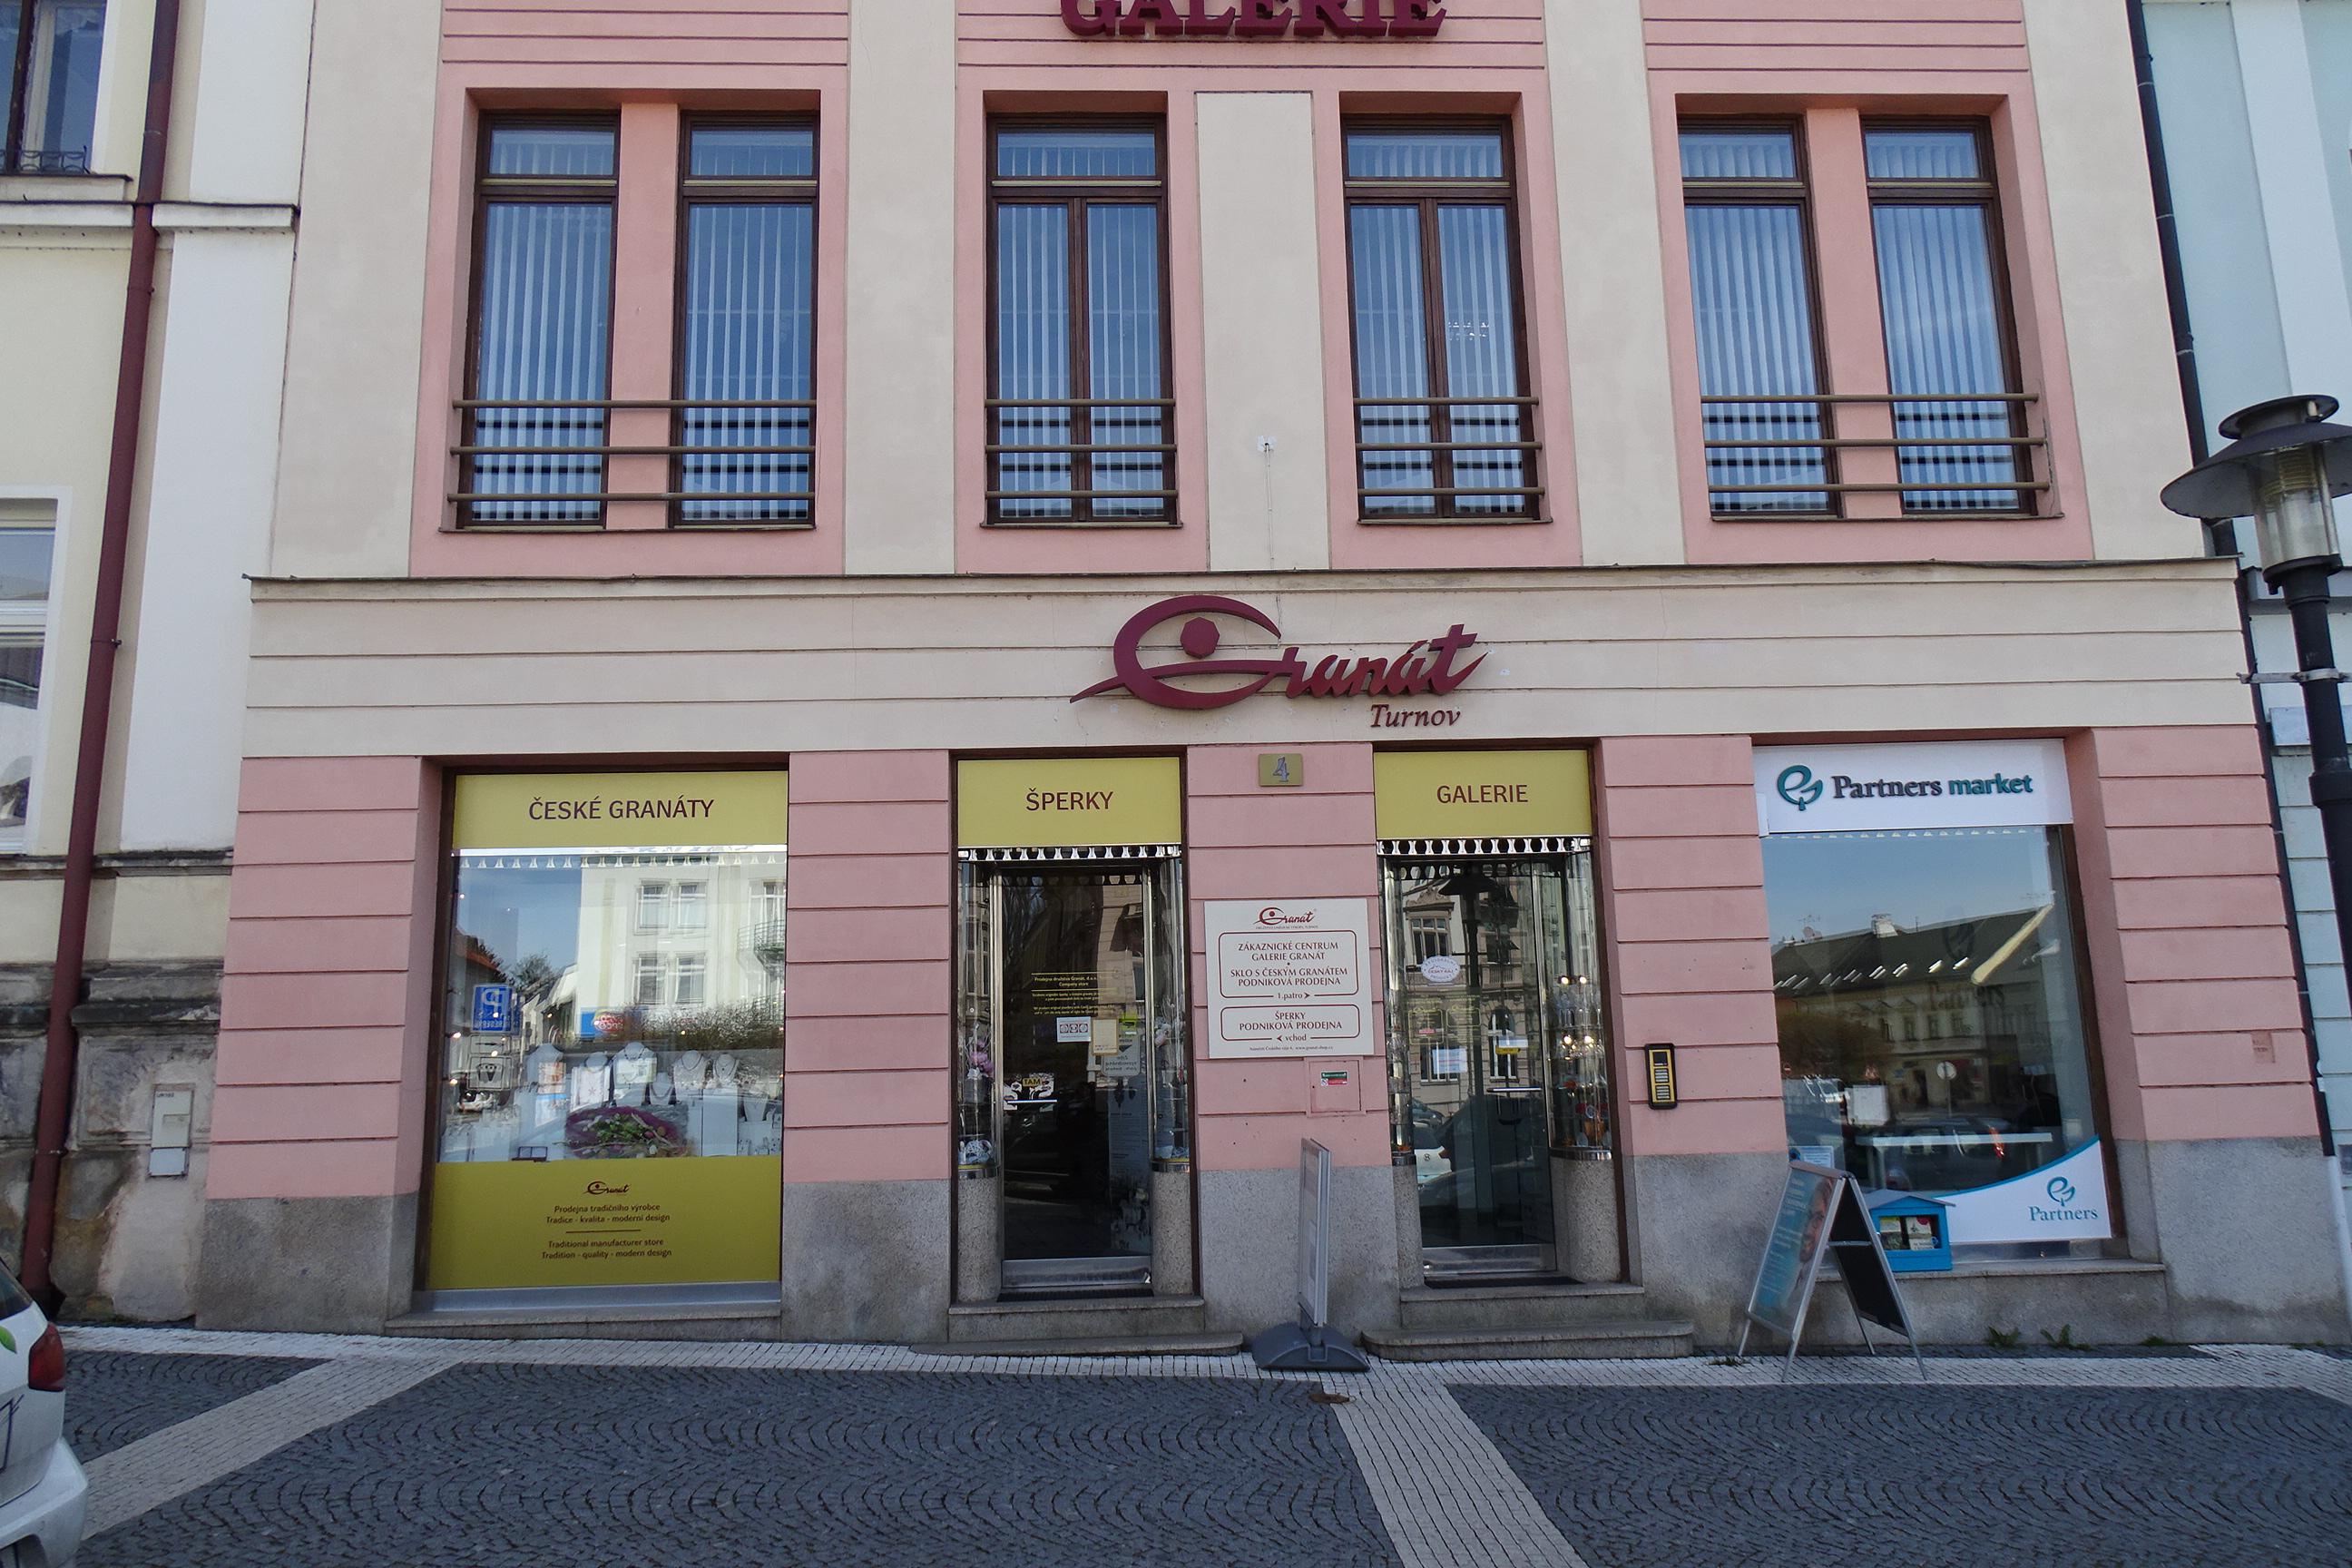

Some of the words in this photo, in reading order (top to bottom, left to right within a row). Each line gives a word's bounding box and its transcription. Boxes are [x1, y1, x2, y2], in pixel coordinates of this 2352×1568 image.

[1370, 704, 1462, 728] Turnov
[1273, 756, 1289, 782] 4
[1832, 775, 1943, 799] Partners
[1948, 773, 2034, 795] market
[1025, 787, 1114, 811] ŠPERKY
[1436, 784, 1529, 804] GALERIE
[528, 796, 602, 820] ČESKÉ
[609, 795, 715, 818] GRANÁTY
[1238, 941, 1293, 952] ZÁKAZNICKÉ
[1295, 942, 1338, 950] CENTRUM
[1251, 953, 1287, 961] GALERIE
[1289, 951, 1326, 960] GRANÁT
[1230, 969, 1253, 977] SKLO
[1255, 968, 1260, 976] S
[1262, 966, 1297, 976] ČESKÝM
[1298, 966, 1348, 976] GRANÁTEM
[1238, 977, 1293, 987] PODNIKOVÁ
[1295, 977, 1341, 986] PRODEJNA
[1275, 1012, 1307, 1020] ŠPERKY
[1239, 1020, 1294, 1031] PODNIKOVÁ
[1296, 1021, 1343, 1030] PRODEJNA
[1285, 1034, 1307, 1042] vchod
[554, 1205, 588, 1214] Prodejna
[631, 1203, 661, 1211] výrobce
[2028, 1206, 2099, 1220] Partners
[645, 1214, 671, 1222] design
[591, 1239, 642, 1247] manufacturer
[582, 1251, 609, 1259] quality
[647, 1250, 672, 1258] design
